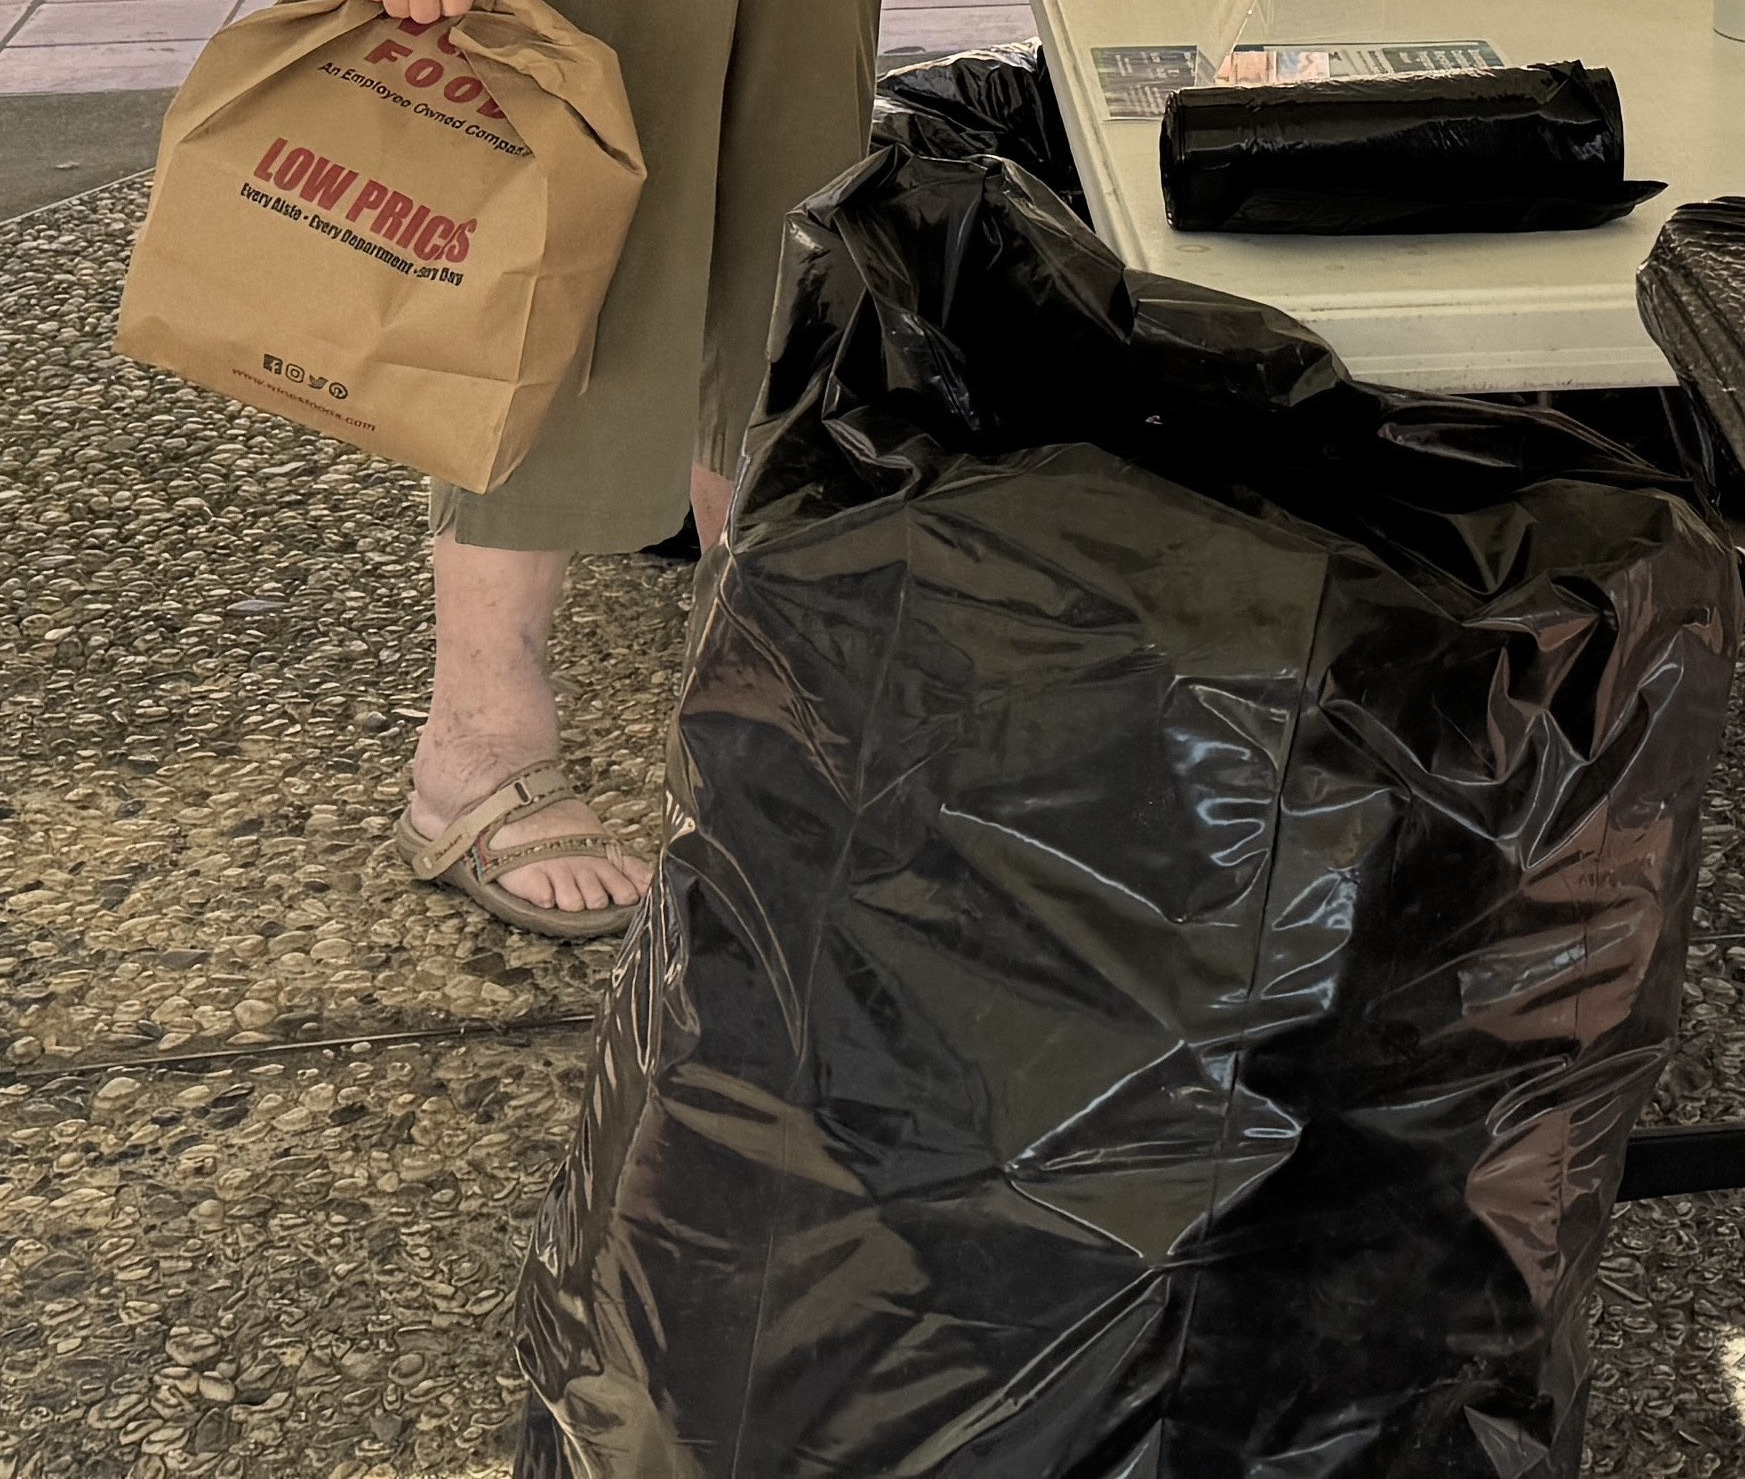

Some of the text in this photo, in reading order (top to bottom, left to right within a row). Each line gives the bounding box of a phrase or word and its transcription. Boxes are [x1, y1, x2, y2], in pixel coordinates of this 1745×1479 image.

[318, 62, 341, 77] An
[341, 68, 411, 108] Employee
[413, 103, 467, 130] Owned
[240, 182, 273, 208] Every
[271, 197, 302, 221] Aisle
[308, 214, 343, 240] Every
[340, 229, 415, 276] Department
[438, 267, 465, 287] Day
[253, 137, 478, 263] LOW PRICS
